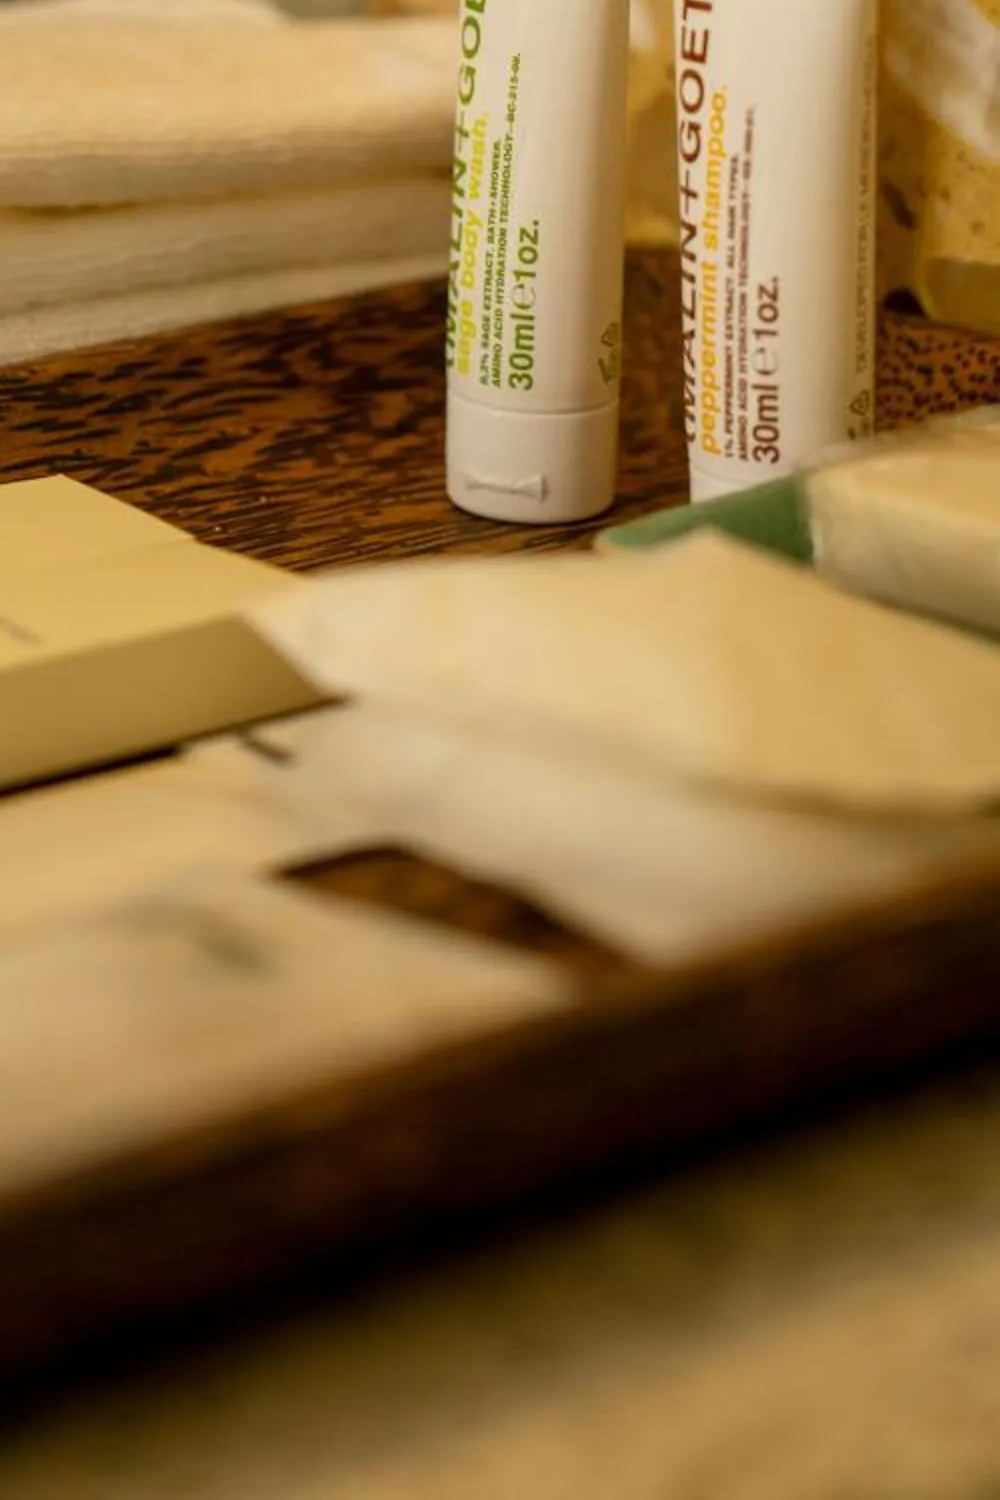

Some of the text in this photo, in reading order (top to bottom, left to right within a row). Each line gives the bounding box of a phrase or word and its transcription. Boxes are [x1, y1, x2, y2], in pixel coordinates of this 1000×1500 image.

[461, 208, 483, 289] body
[495, 227, 507, 303] HYDRATION
[701, 85, 727, 455] peppermint shampoo.
[457, 300, 476, 375] sage
[482, 314, 491, 348] SAGE
[493, 308, 504, 341] ACID
[753, 276, 780, 337] 1oz.
[492, 343, 502, 387] AMINO
[508, 313, 535, 390] 30ml
[738, 378, 749, 411] ACID
[751, 383, 780, 464] 30ml
[738, 416, 749, 462] AMINO
